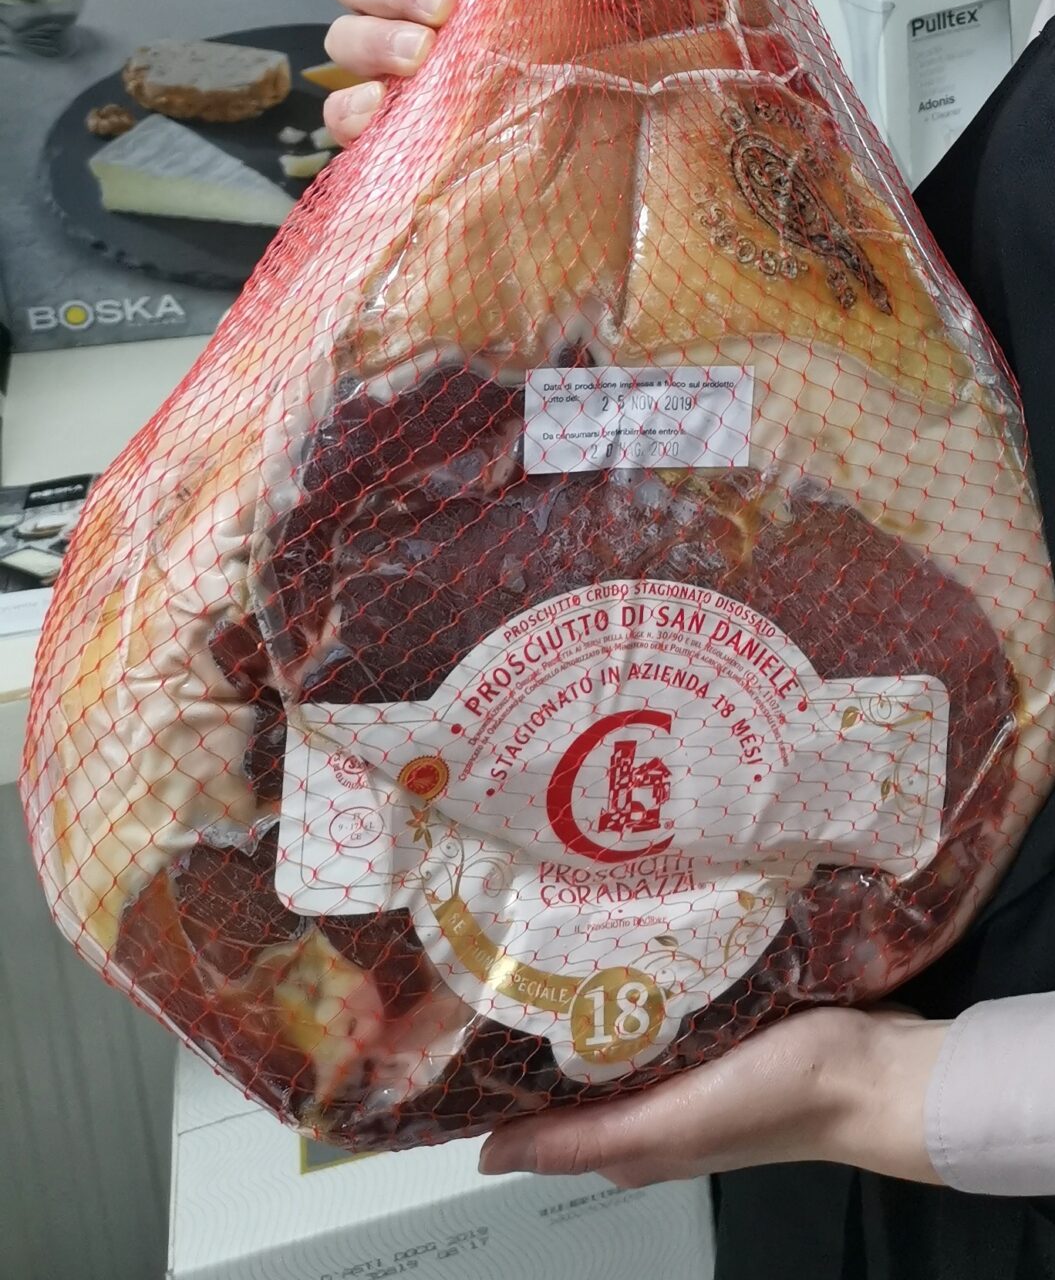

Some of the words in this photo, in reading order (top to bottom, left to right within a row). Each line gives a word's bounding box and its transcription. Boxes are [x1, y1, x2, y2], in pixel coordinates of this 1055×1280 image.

[911, 7, 980, 38] Pulltex
[918, 94, 956, 114] Adonis
[28, 293, 187, 331] BOSKA
[564, 383, 573, 391] di
[688, 380, 700, 389] sul
[702, 380, 735, 390] prodotto
[631, 394, 653, 411] NOV
[664, 394, 693, 412] 2019
[543, 432, 554, 441] Da
[658, 428, 679, 436] entro
[650, 441, 679, 457] 2020
[503, 594, 581, 643] PROSCIUTTO
[586, 583, 629, 602] CRUDO
[634, 582, 712, 604] STAGIONATO
[714, 597, 776, 638] DISOSSATO
[656, 630, 684, 642] 30/90
[464, 609, 609, 717] PROSCIUTTO
[621, 604, 645, 628] DI
[656, 605, 707, 635] SAN
[710, 620, 799, 700] DANIELE
[491, 676, 593, 781] STAGIONATO
[600, 665, 621, 686] IN
[627, 662, 711, 699] AZIENDA
[712, 693, 736, 718] 18
[731, 718, 763, 765] MESI
[540, 870, 695, 908] CORADAZZI
[506, 970, 569, 1003] PECIALE
[585, 981, 650, 1046] 18
